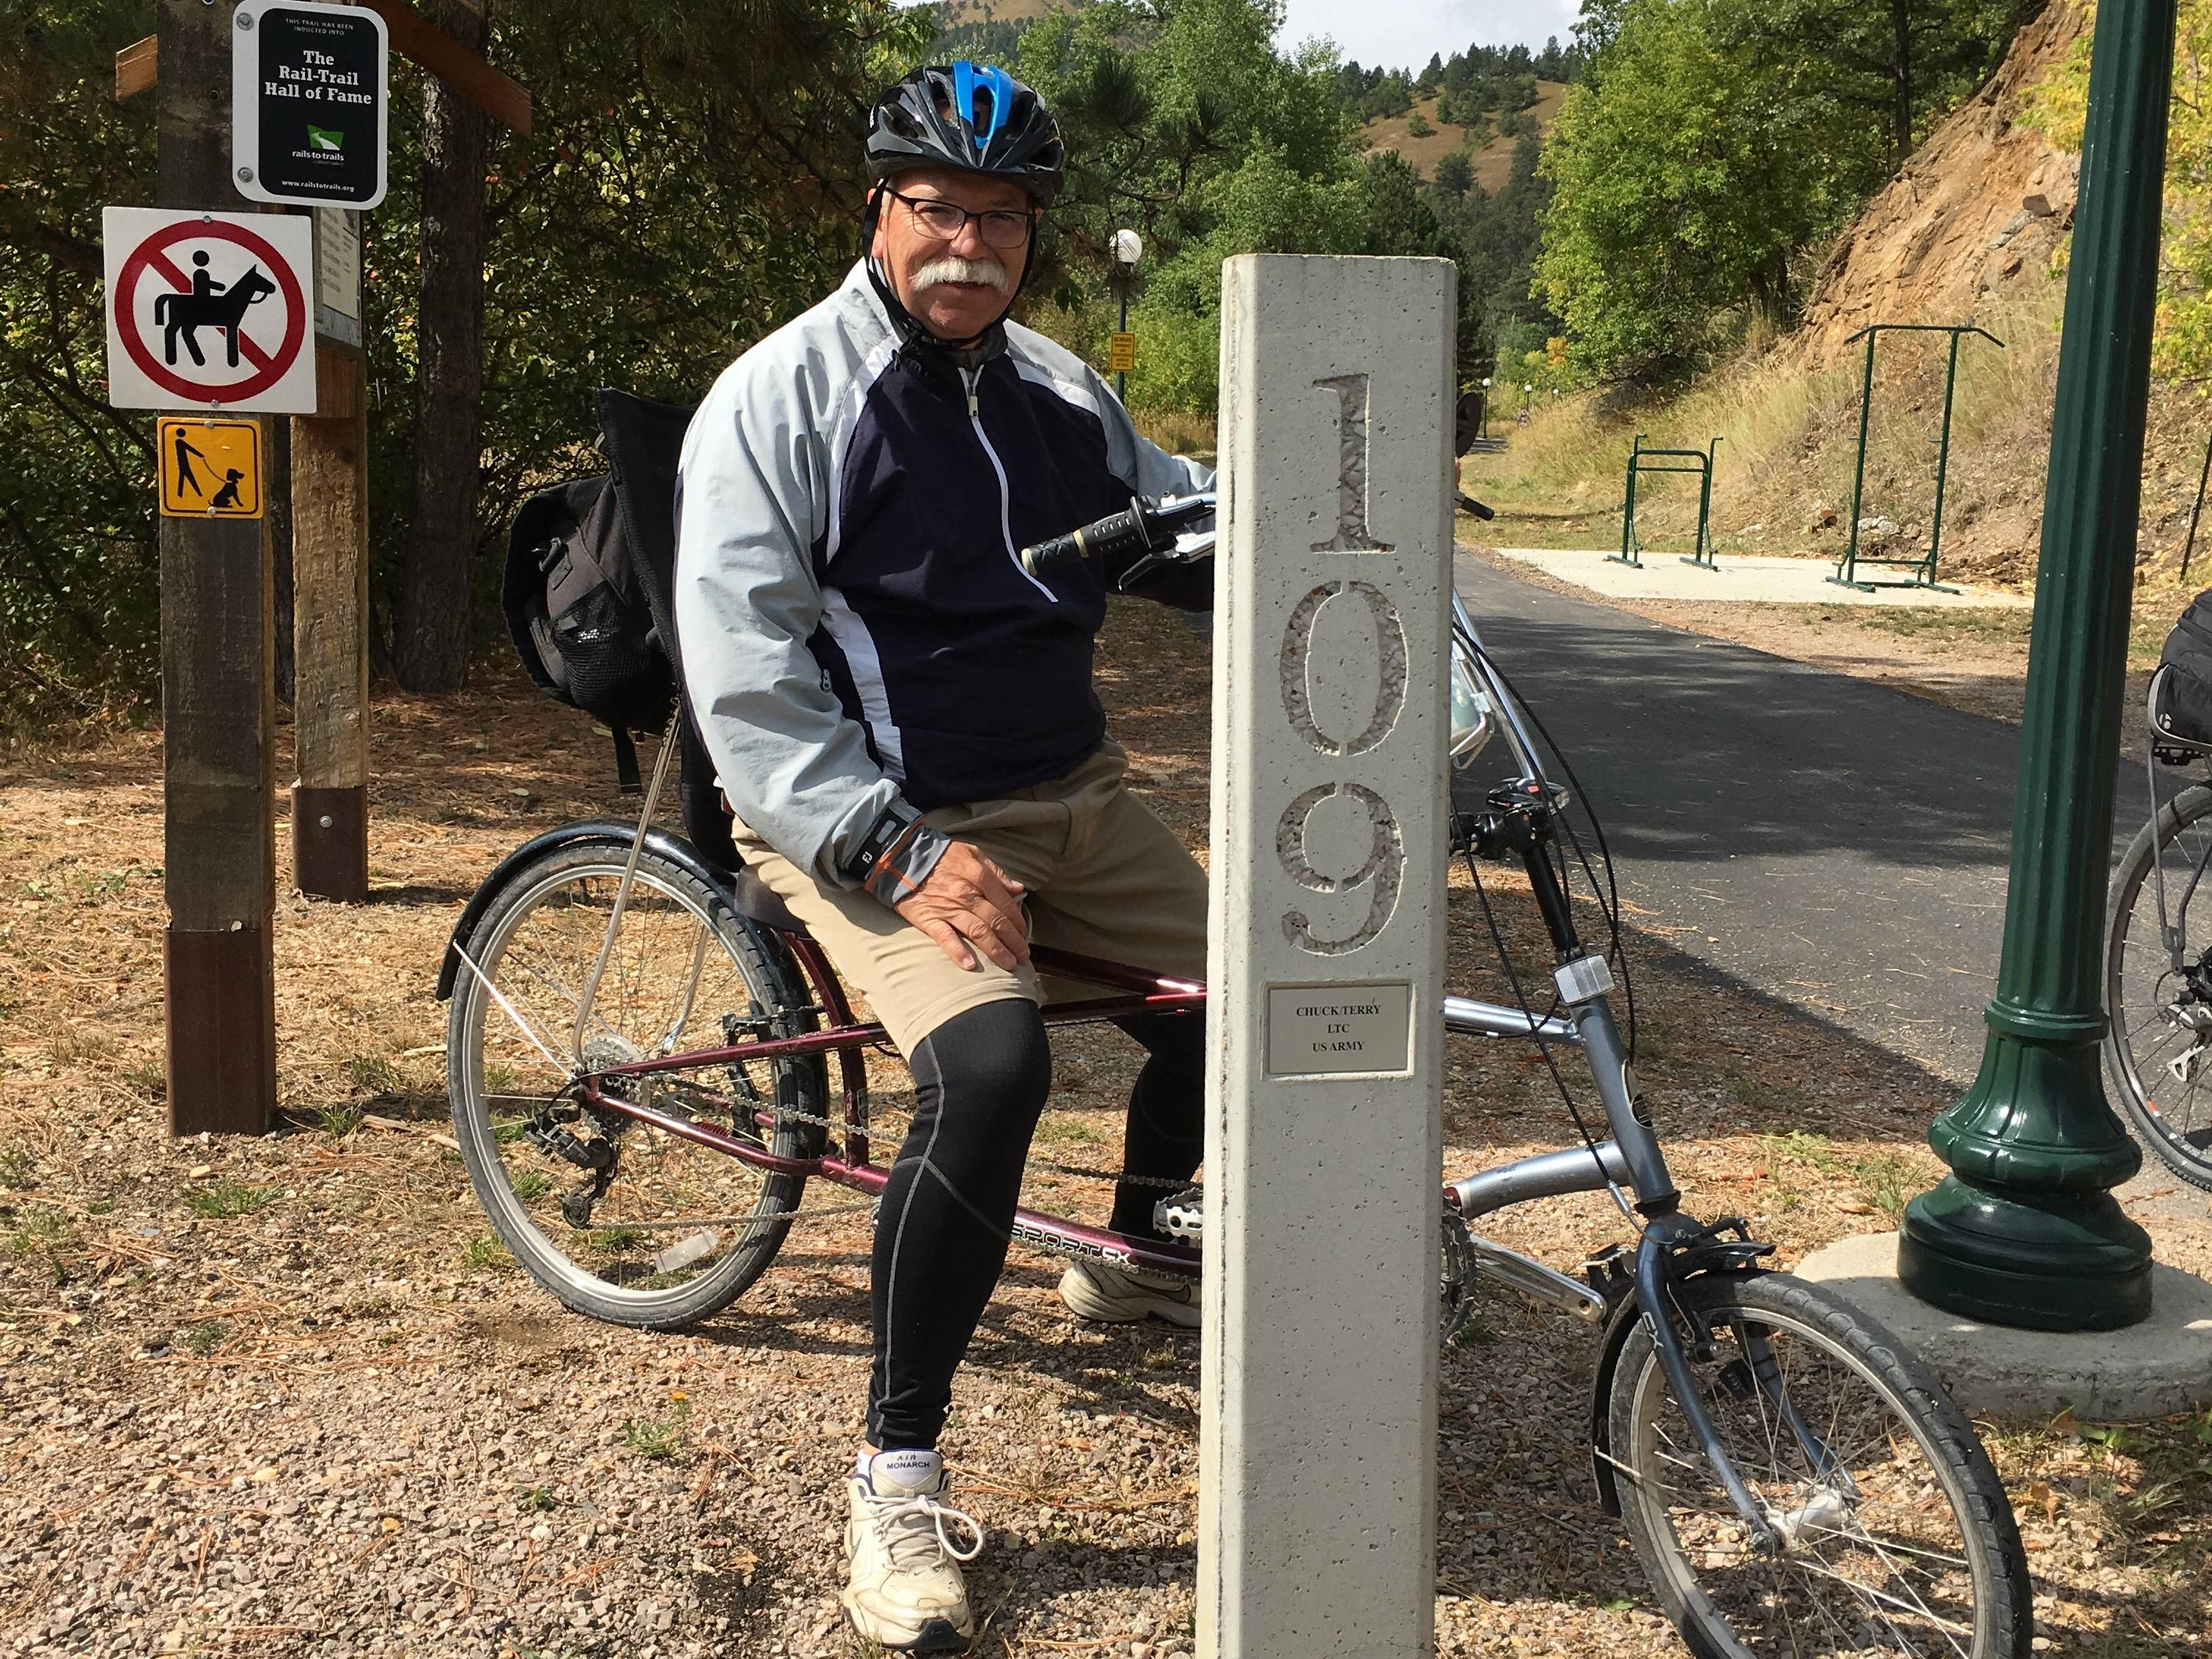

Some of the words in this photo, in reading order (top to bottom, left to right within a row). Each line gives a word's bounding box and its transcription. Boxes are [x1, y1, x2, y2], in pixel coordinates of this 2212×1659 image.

[294, 26, 327, 34] INDUCTED
[303, 50, 334, 66] The
[279, 65, 359, 86] Rail-Trail
[265, 81, 300, 98] Hall
[305, 87, 322, 100] of
[327, 87, 372, 105] Fame
[282, 180, 354, 193] www.railstotrails.org
[1327, 1023, 1350, 1034] LTC
[1312, 1042, 1327, 1052] US
[1330, 1041, 1364, 1051] ARMY
[1011, 1222, 1101, 1257] SPORT
[886, 1461, 930, 1469] MONARCH
